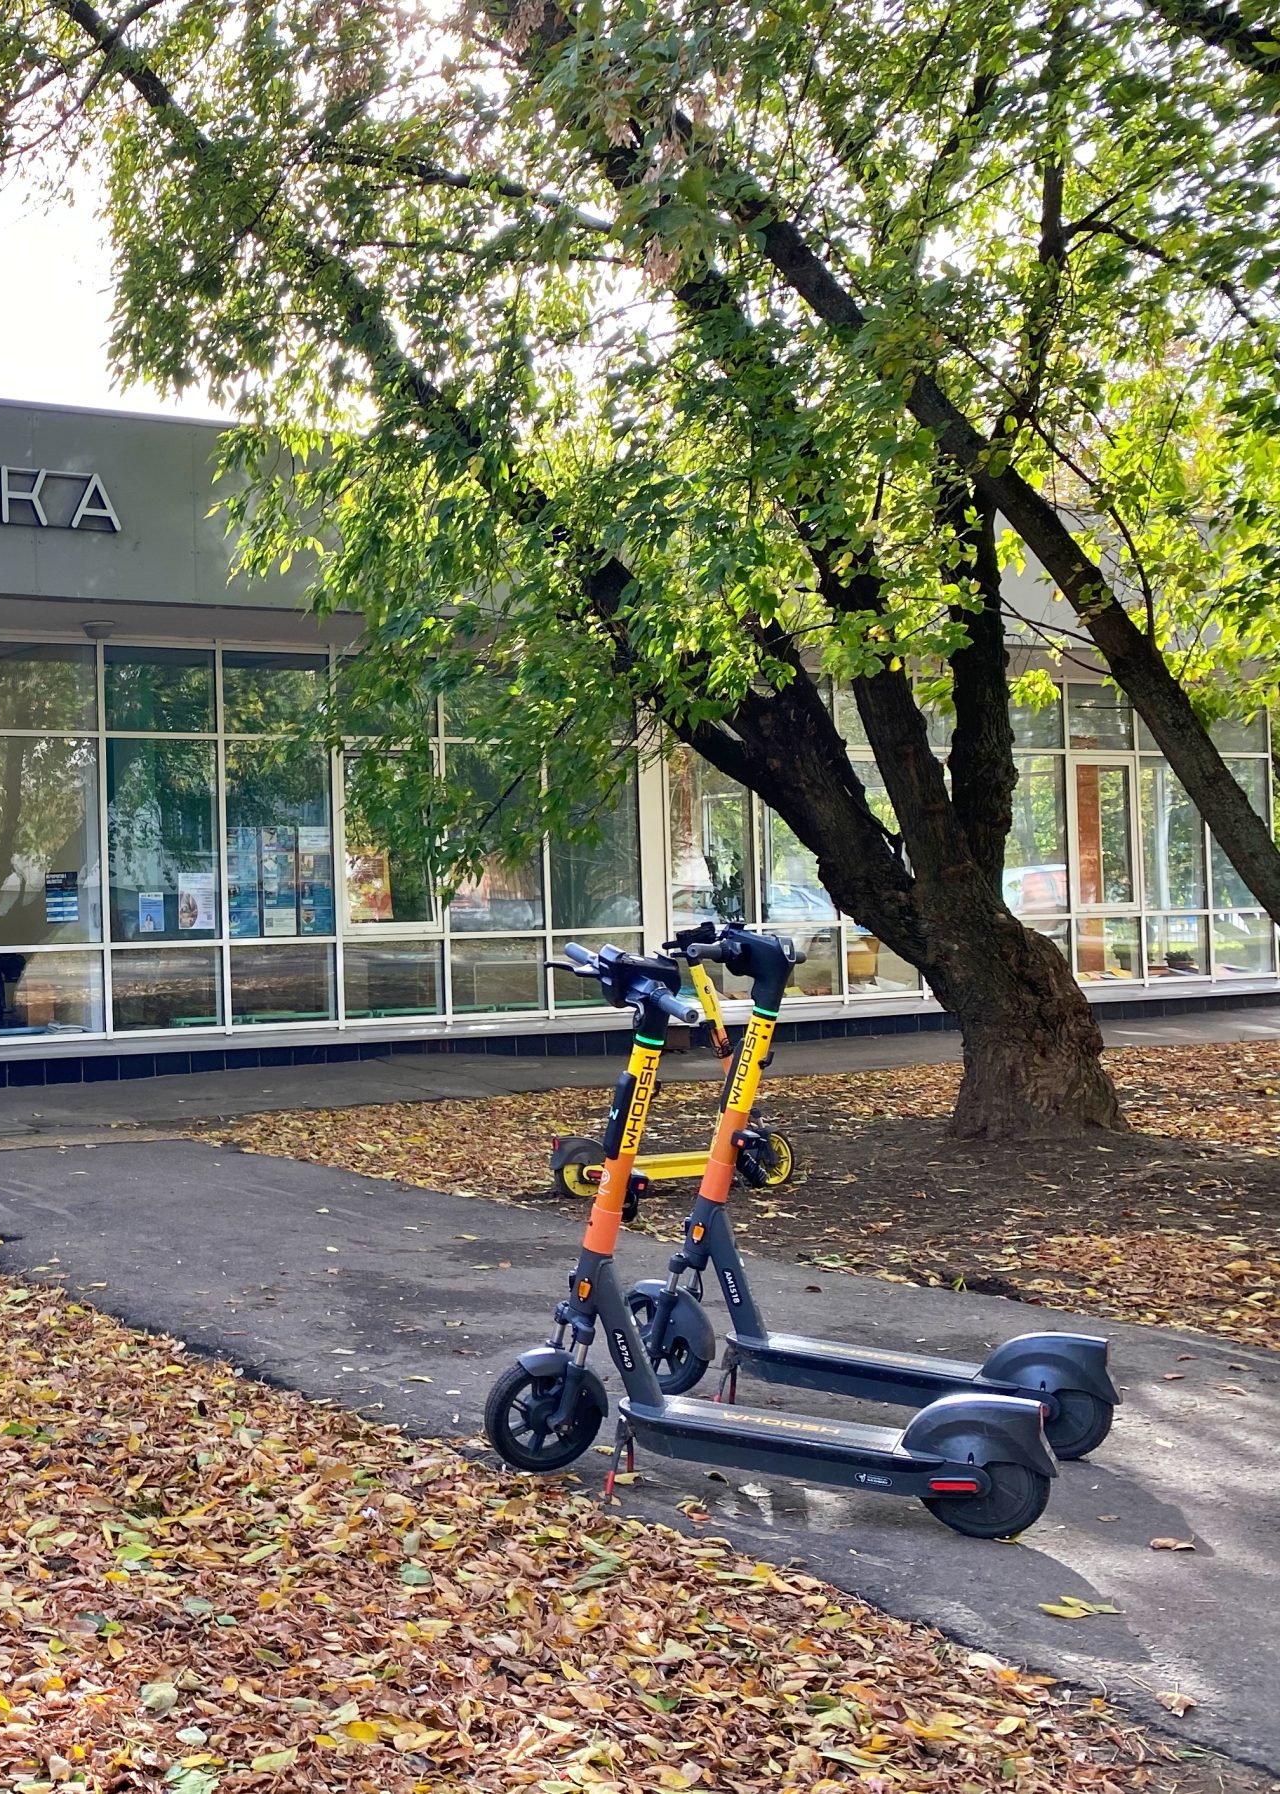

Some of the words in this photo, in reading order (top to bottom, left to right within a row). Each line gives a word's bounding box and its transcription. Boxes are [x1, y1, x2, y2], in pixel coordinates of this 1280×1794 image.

[729, 1021, 761, 1105] WHOOSH
[623, 1056, 657, 1149] WHOOSH
[723, 1271, 740, 1304] AM1518
[614, 1332, 633, 1368] AL9749
[723, 1411, 841, 1435] WHOOSH
